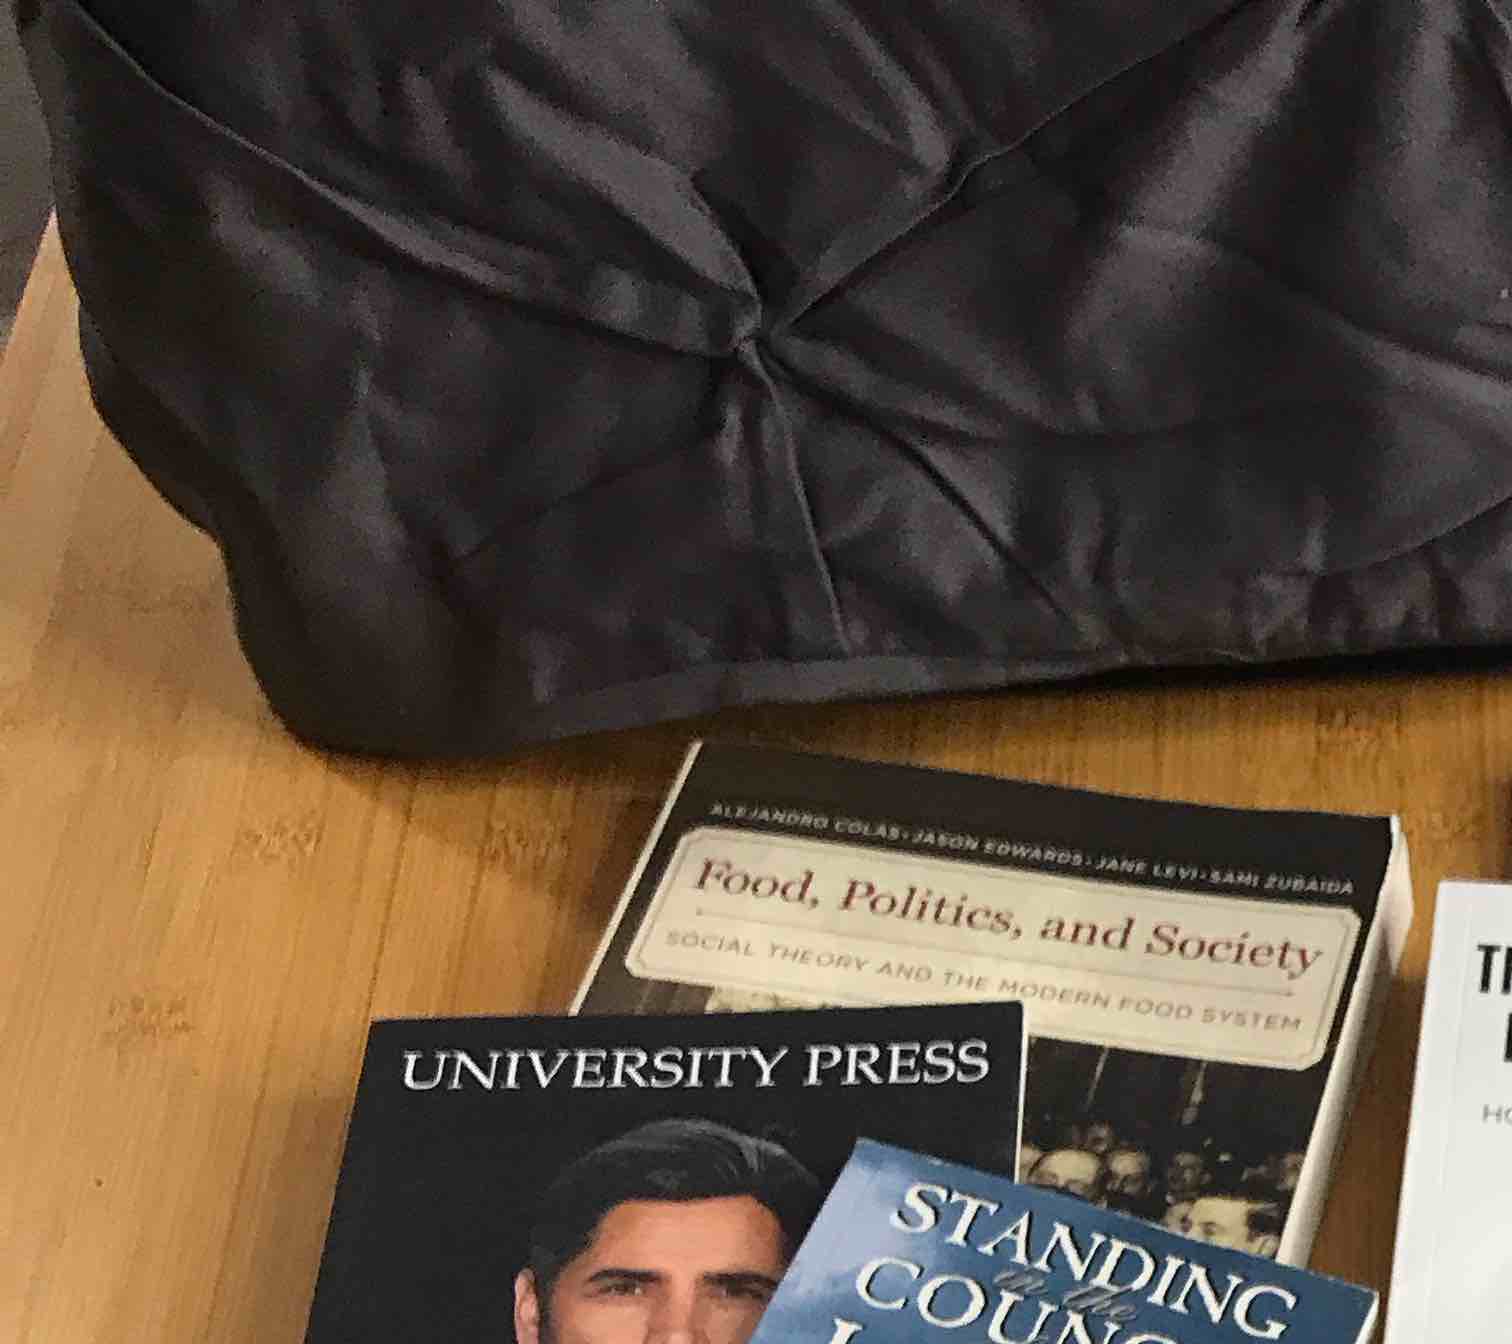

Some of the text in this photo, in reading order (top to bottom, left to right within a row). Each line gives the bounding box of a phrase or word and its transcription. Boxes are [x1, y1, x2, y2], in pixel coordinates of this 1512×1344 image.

[710, 803, 829, 830] ALEJANDRO
[911, 828, 979, 851] JASON
[983, 841, 1083, 868] EDWARDS
[1095, 856, 1147, 875] JANE
[1151, 863, 1199, 882] LEVI
[1208, 869, 1259, 889] SAMI
[1263, 873, 1354, 896] ZUBAIDA
[697, 856, 1325, 981] Food, Politics, and Society
[664, 930, 1302, 1032] SOCIAL THEORY AND THE MODERN FOOD SYSTEM
[401, 1040, 992, 1092] UNIVERSITY PRESS
[890, 1183, 1296, 1340] STANDING
